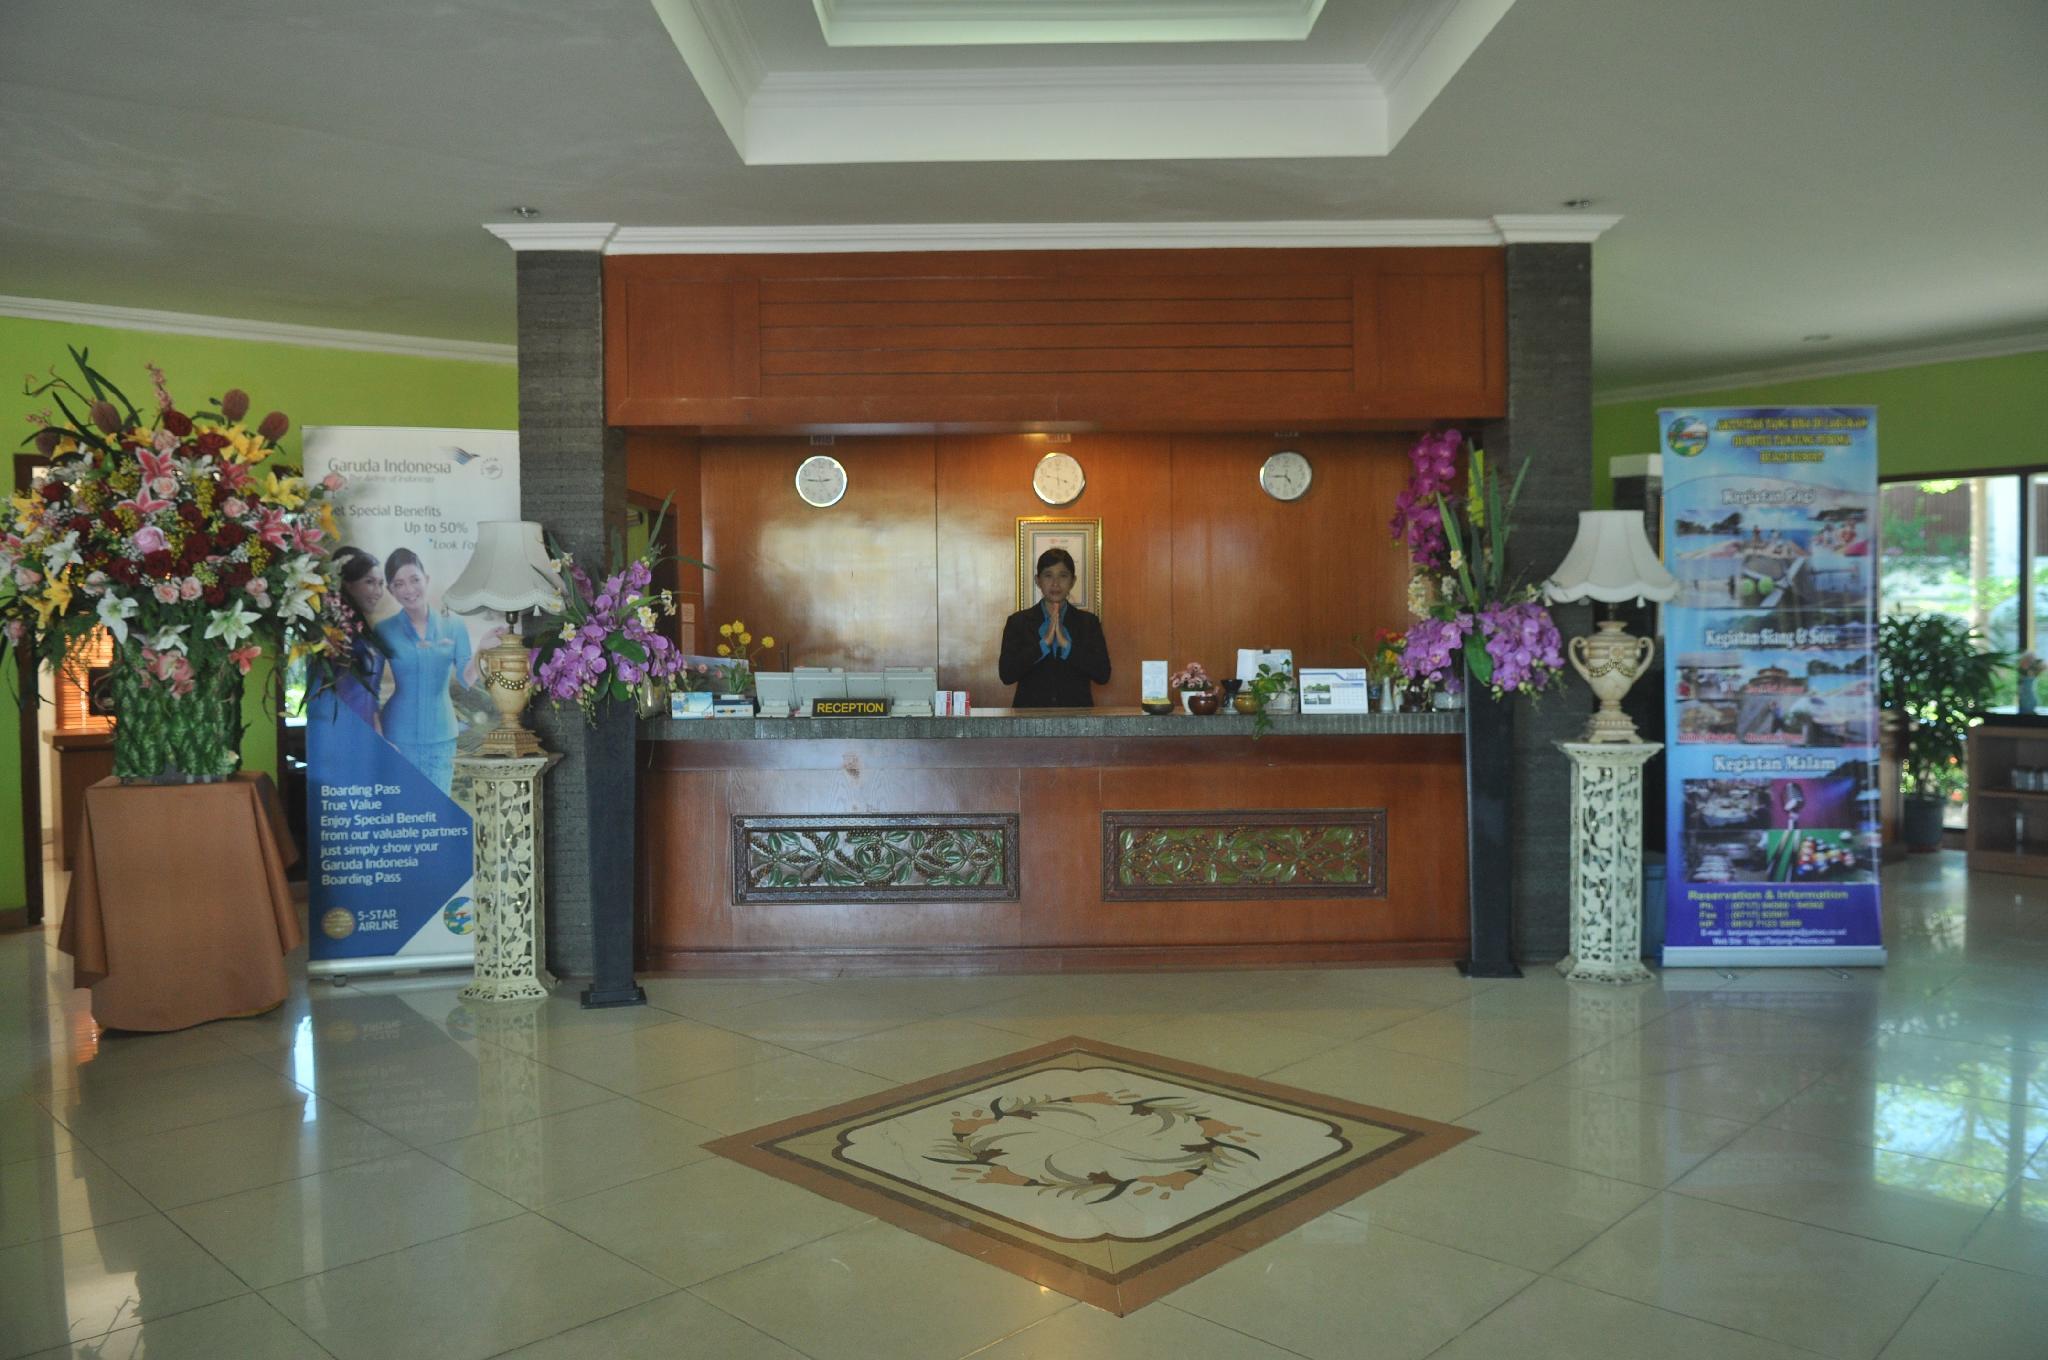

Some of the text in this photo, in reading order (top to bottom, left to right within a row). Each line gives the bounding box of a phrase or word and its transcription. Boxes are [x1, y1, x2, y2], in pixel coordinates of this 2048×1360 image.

[328, 457, 452, 473] Garuda Indonesia
[350, 505, 391, 518] Special
[394, 504, 442, 517] Benefits
[404, 521, 469, 535] Up to 50%
[1705, 630, 1759, 648] Kegiatan
[816, 702, 884, 714] RECEPTION
[1713, 755, 1836, 773] Kegiatan Malam
[320, 784, 401, 797] Boarding Pass
[321, 799, 382, 811] True Value
[320, 812, 437, 828] Enjoy Special Benefit
[320, 826, 468, 842] from our valuable partners
[320, 843, 439, 858] just simply show your
[321, 857, 419, 872] Garuda Indonesia
[321, 872, 401, 887] Boarding Pass
[1687, 889, 1849, 900] Reservation & Information
[357, 909, 397, 920] 5-STAR
[358, 920, 399, 932] AIRLINE
